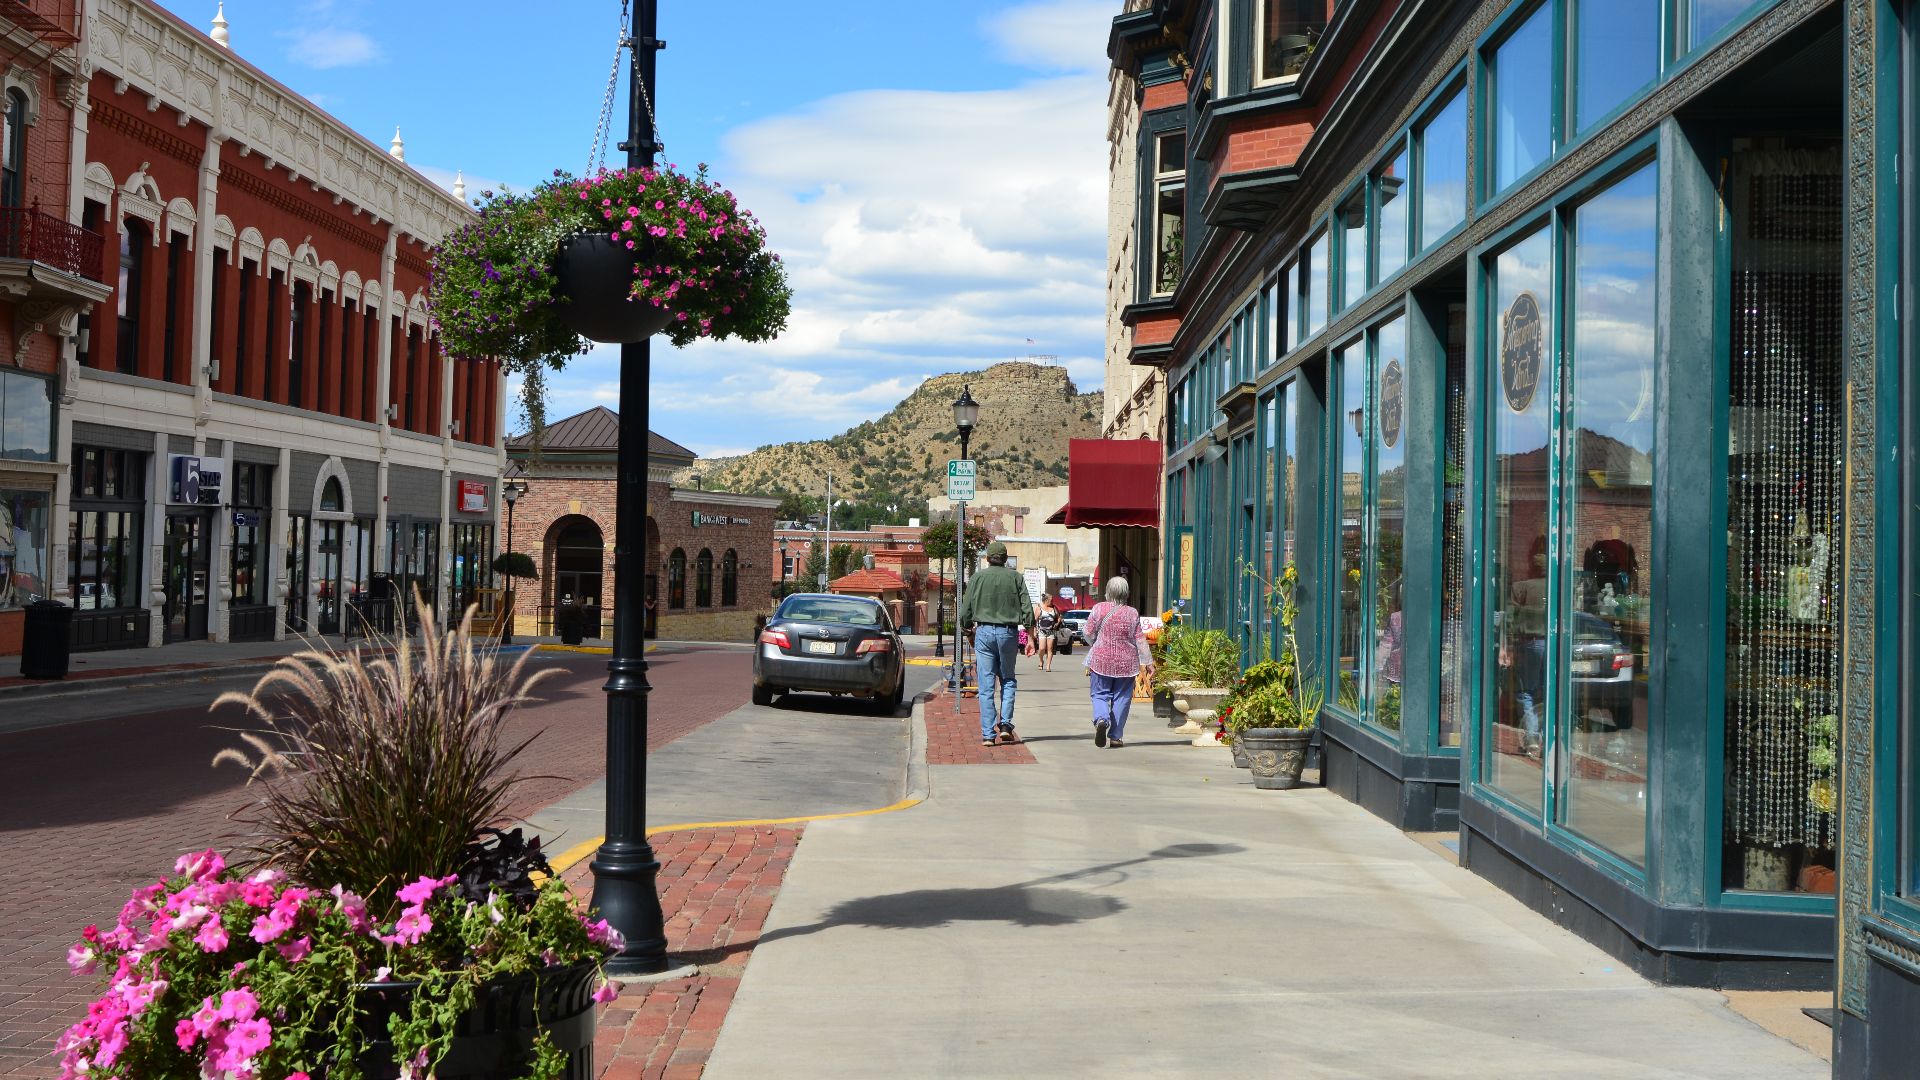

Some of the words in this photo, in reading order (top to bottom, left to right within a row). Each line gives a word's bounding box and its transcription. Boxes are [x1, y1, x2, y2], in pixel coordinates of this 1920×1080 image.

[950, 462, 956, 473] 2
[186, 460, 200, 504] 5
[200, 471, 221, 486] STAR
[236, 513, 245, 526] 5
[1182, 540, 1190, 596] OPEN
